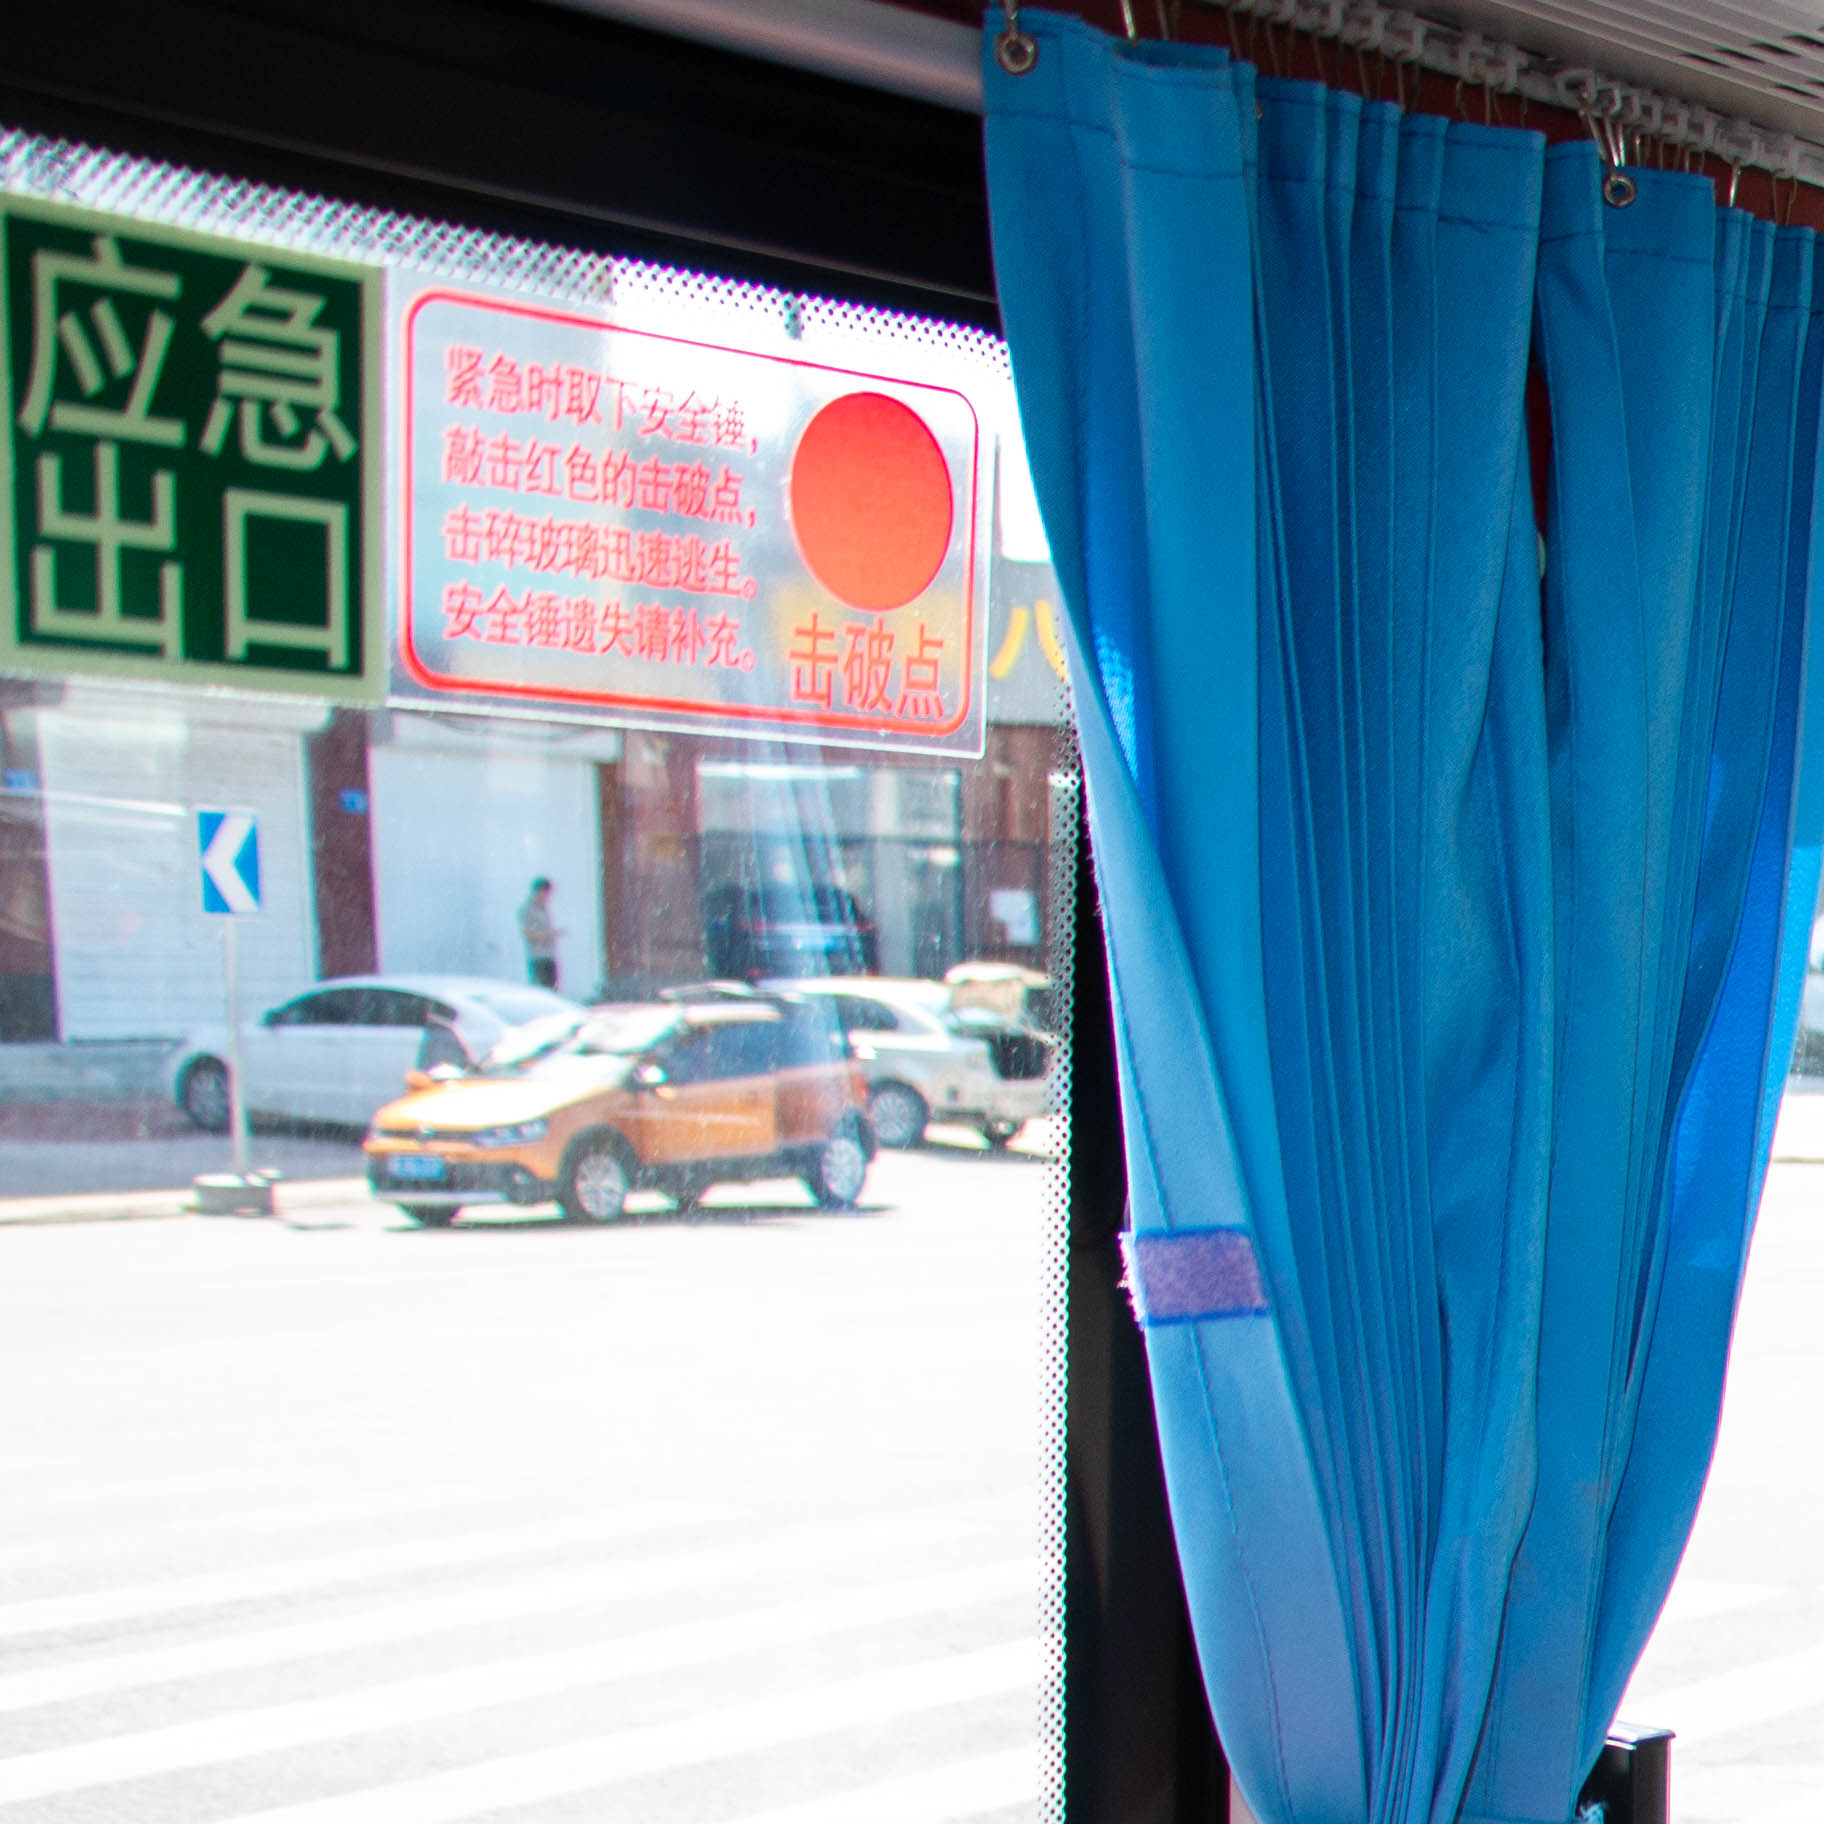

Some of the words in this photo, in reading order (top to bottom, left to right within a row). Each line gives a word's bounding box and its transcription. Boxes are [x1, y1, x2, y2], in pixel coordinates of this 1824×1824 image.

[18, 234, 358, 472] 应急
[441, 423, 756, 528] 敲击红色的击破点，
[28, 443, 350, 671] 出口
[441, 502, 757, 600] 击碎玻璃迅速逃生。
[441, 580, 755, 671] 安全锤遗失请补充。
[788, 612, 949, 722] 击破点
